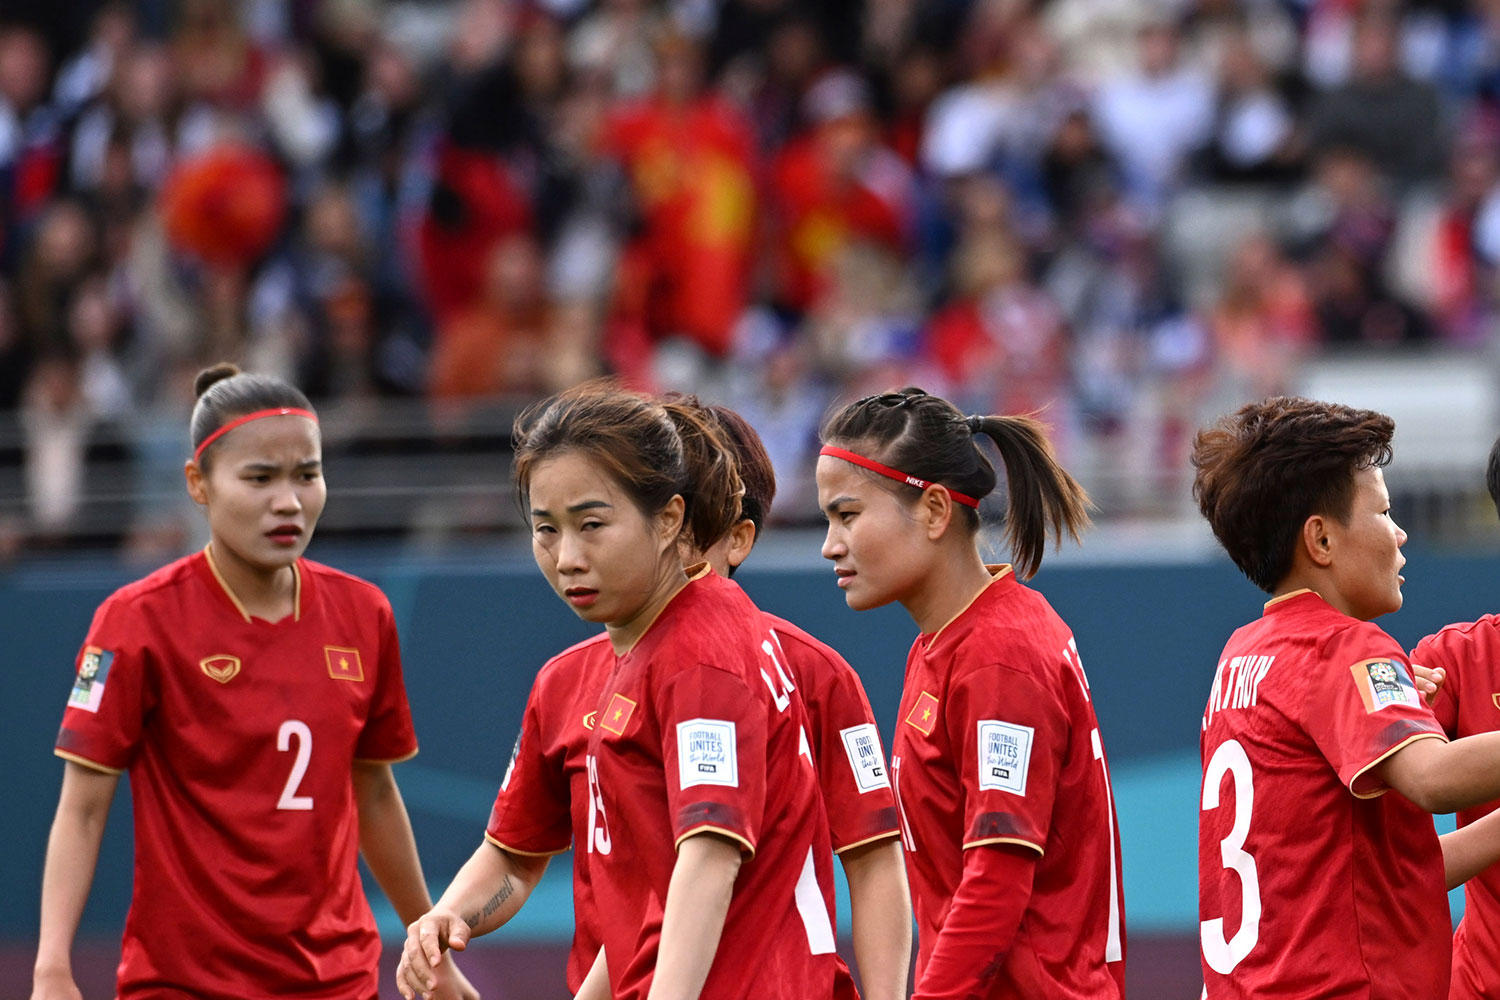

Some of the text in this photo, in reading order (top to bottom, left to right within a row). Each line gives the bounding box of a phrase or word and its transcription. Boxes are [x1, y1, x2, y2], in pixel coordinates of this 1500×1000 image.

[906, 476, 925, 488] NIKE
[1222, 655, 1276, 710] THUY
[689, 730, 721, 741] FOOTBALL
[988, 732, 1018, 746] FOOTBALL
[689, 740, 723, 753] UNITES
[988, 742, 1018, 758] UNITES
[702, 752, 726, 763] World
[997, 756, 1019, 770] World
[276, 719, 314, 811] 2
